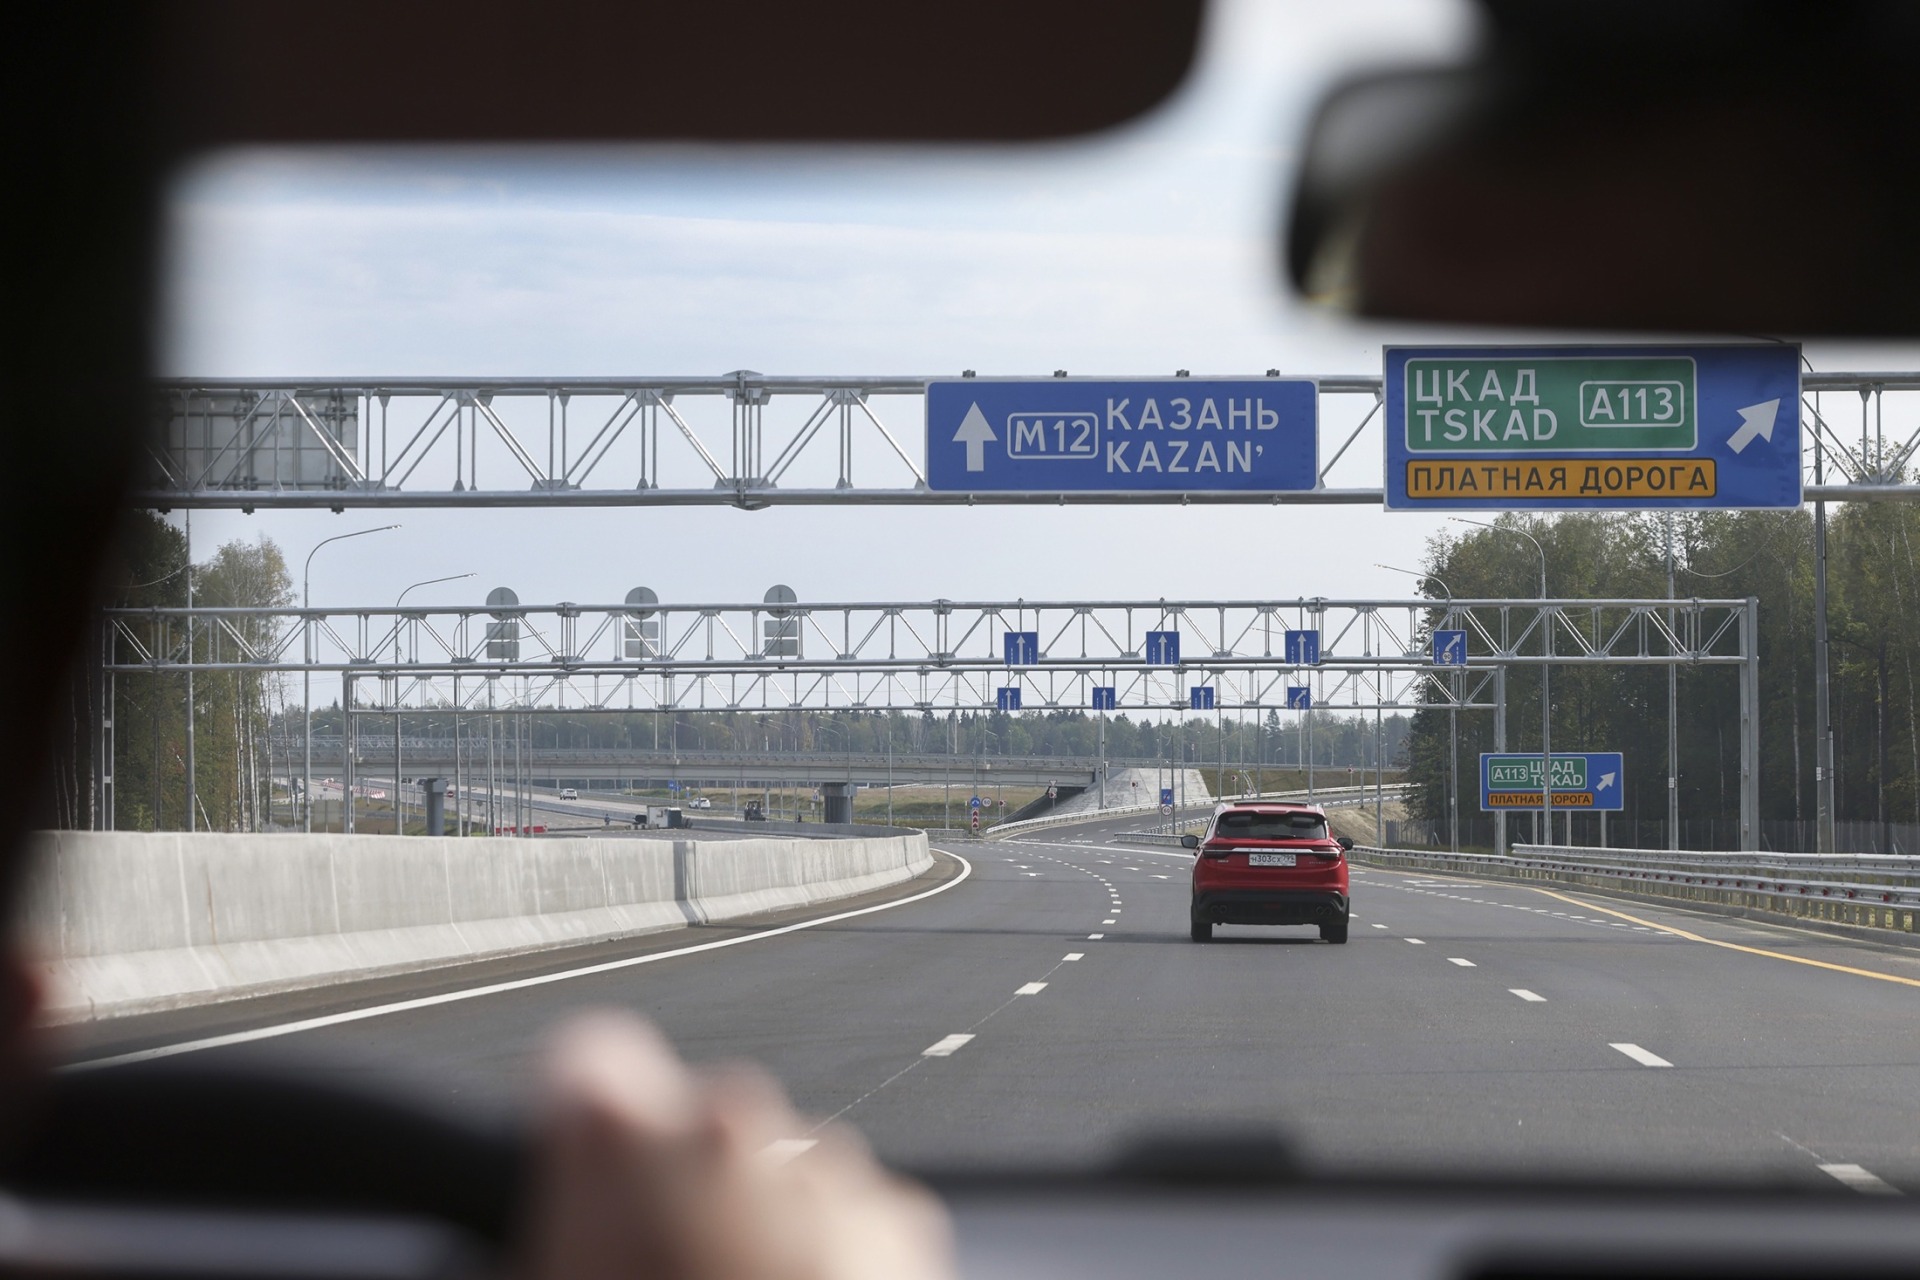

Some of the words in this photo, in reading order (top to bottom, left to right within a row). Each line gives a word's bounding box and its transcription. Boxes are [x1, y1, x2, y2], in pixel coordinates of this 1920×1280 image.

[1415, 369, 1540, 407] ЦКАД
[1588, 387, 1675, 420] А113
[1106, 398, 1279, 430] КАЗАНЬ
[1416, 409, 1558, 442] TSKAD
[1106, 441, 1263, 473] KAZAN’
[1413, 467, 1567, 491] ПЛАТНАЯ
[1579, 466, 1709, 494] ДОРОГА
[1490, 795, 1543, 804] ПЛАТНАЯ
